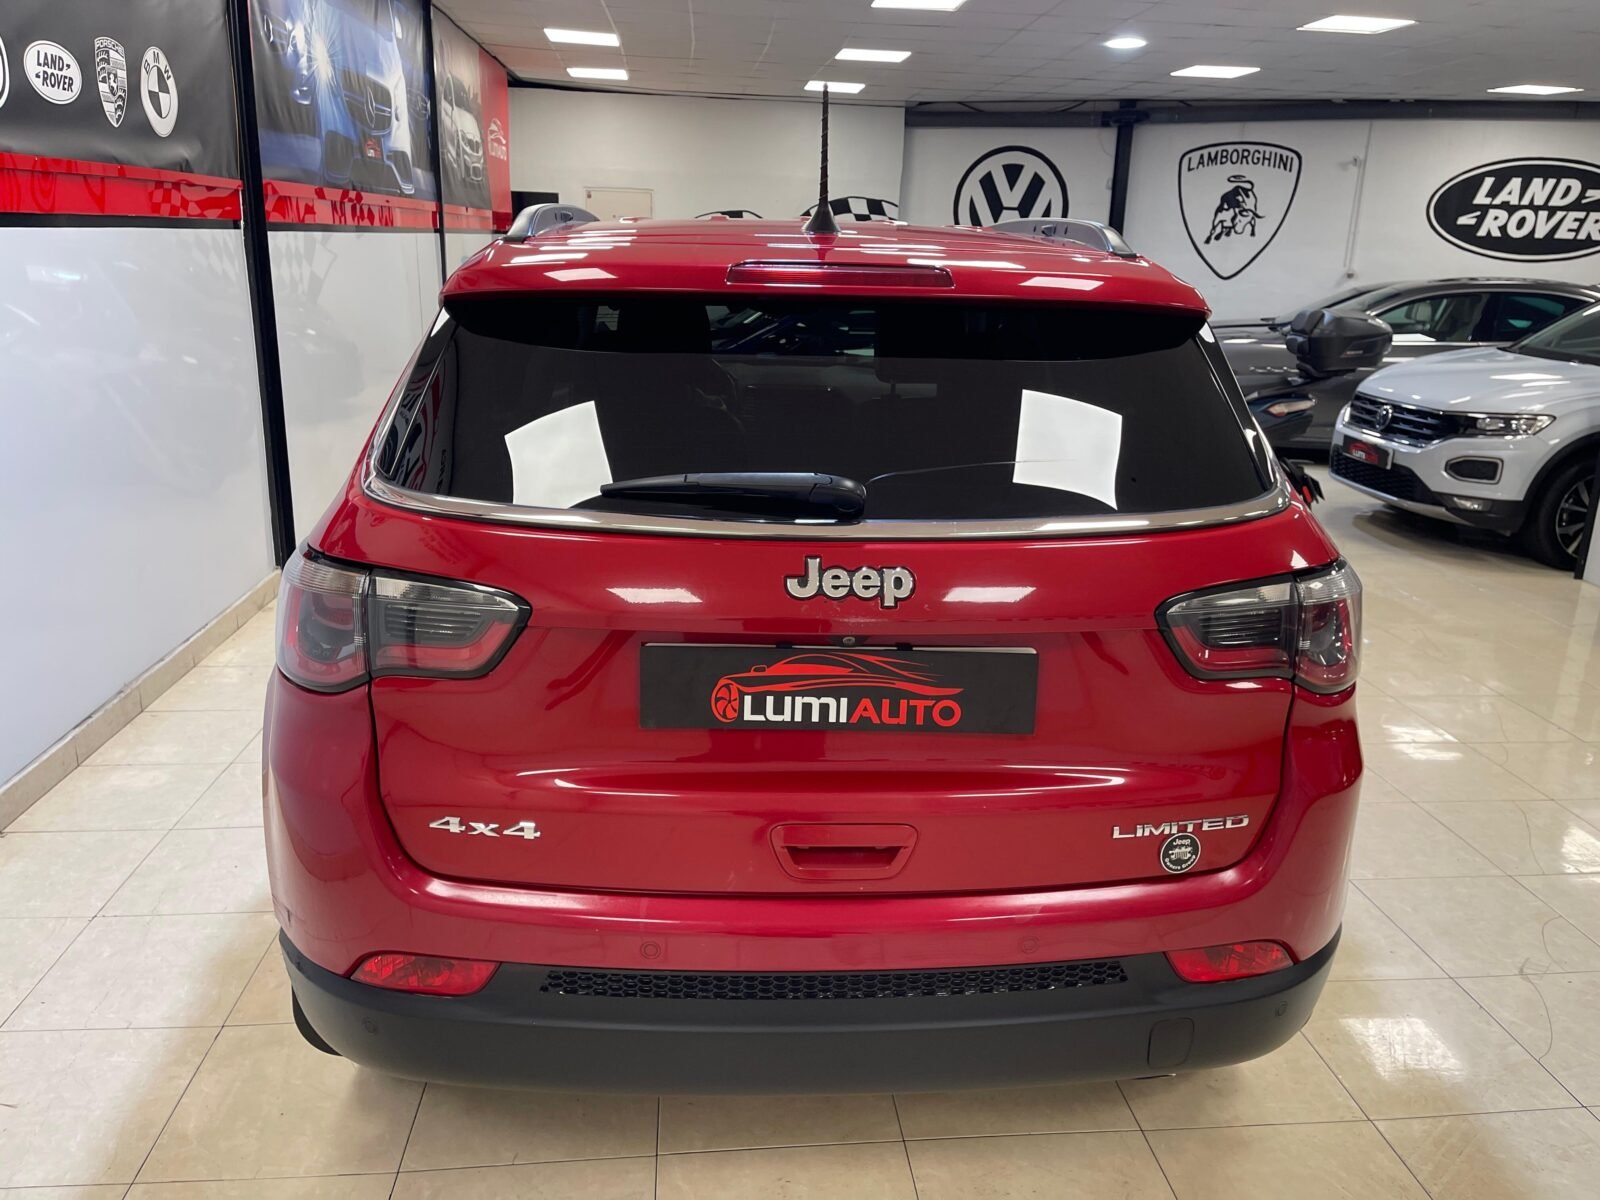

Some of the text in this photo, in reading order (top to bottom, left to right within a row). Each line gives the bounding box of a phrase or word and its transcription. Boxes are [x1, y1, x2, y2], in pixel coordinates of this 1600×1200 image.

[36, 50, 65, 71] LAND
[143, 50, 172, 81] BMW
[42, 72, 74, 93] ROVER
[1187, 148, 1294, 173] LAMBORGHINI
[1472, 176, 1582, 207] LAND
[1475, 208, 1600, 240] ROVER
[785, 556, 915, 608] Jeep
[429, 816, 541, 839] 4x4
[1112, 814, 1250, 839] LIMITED
